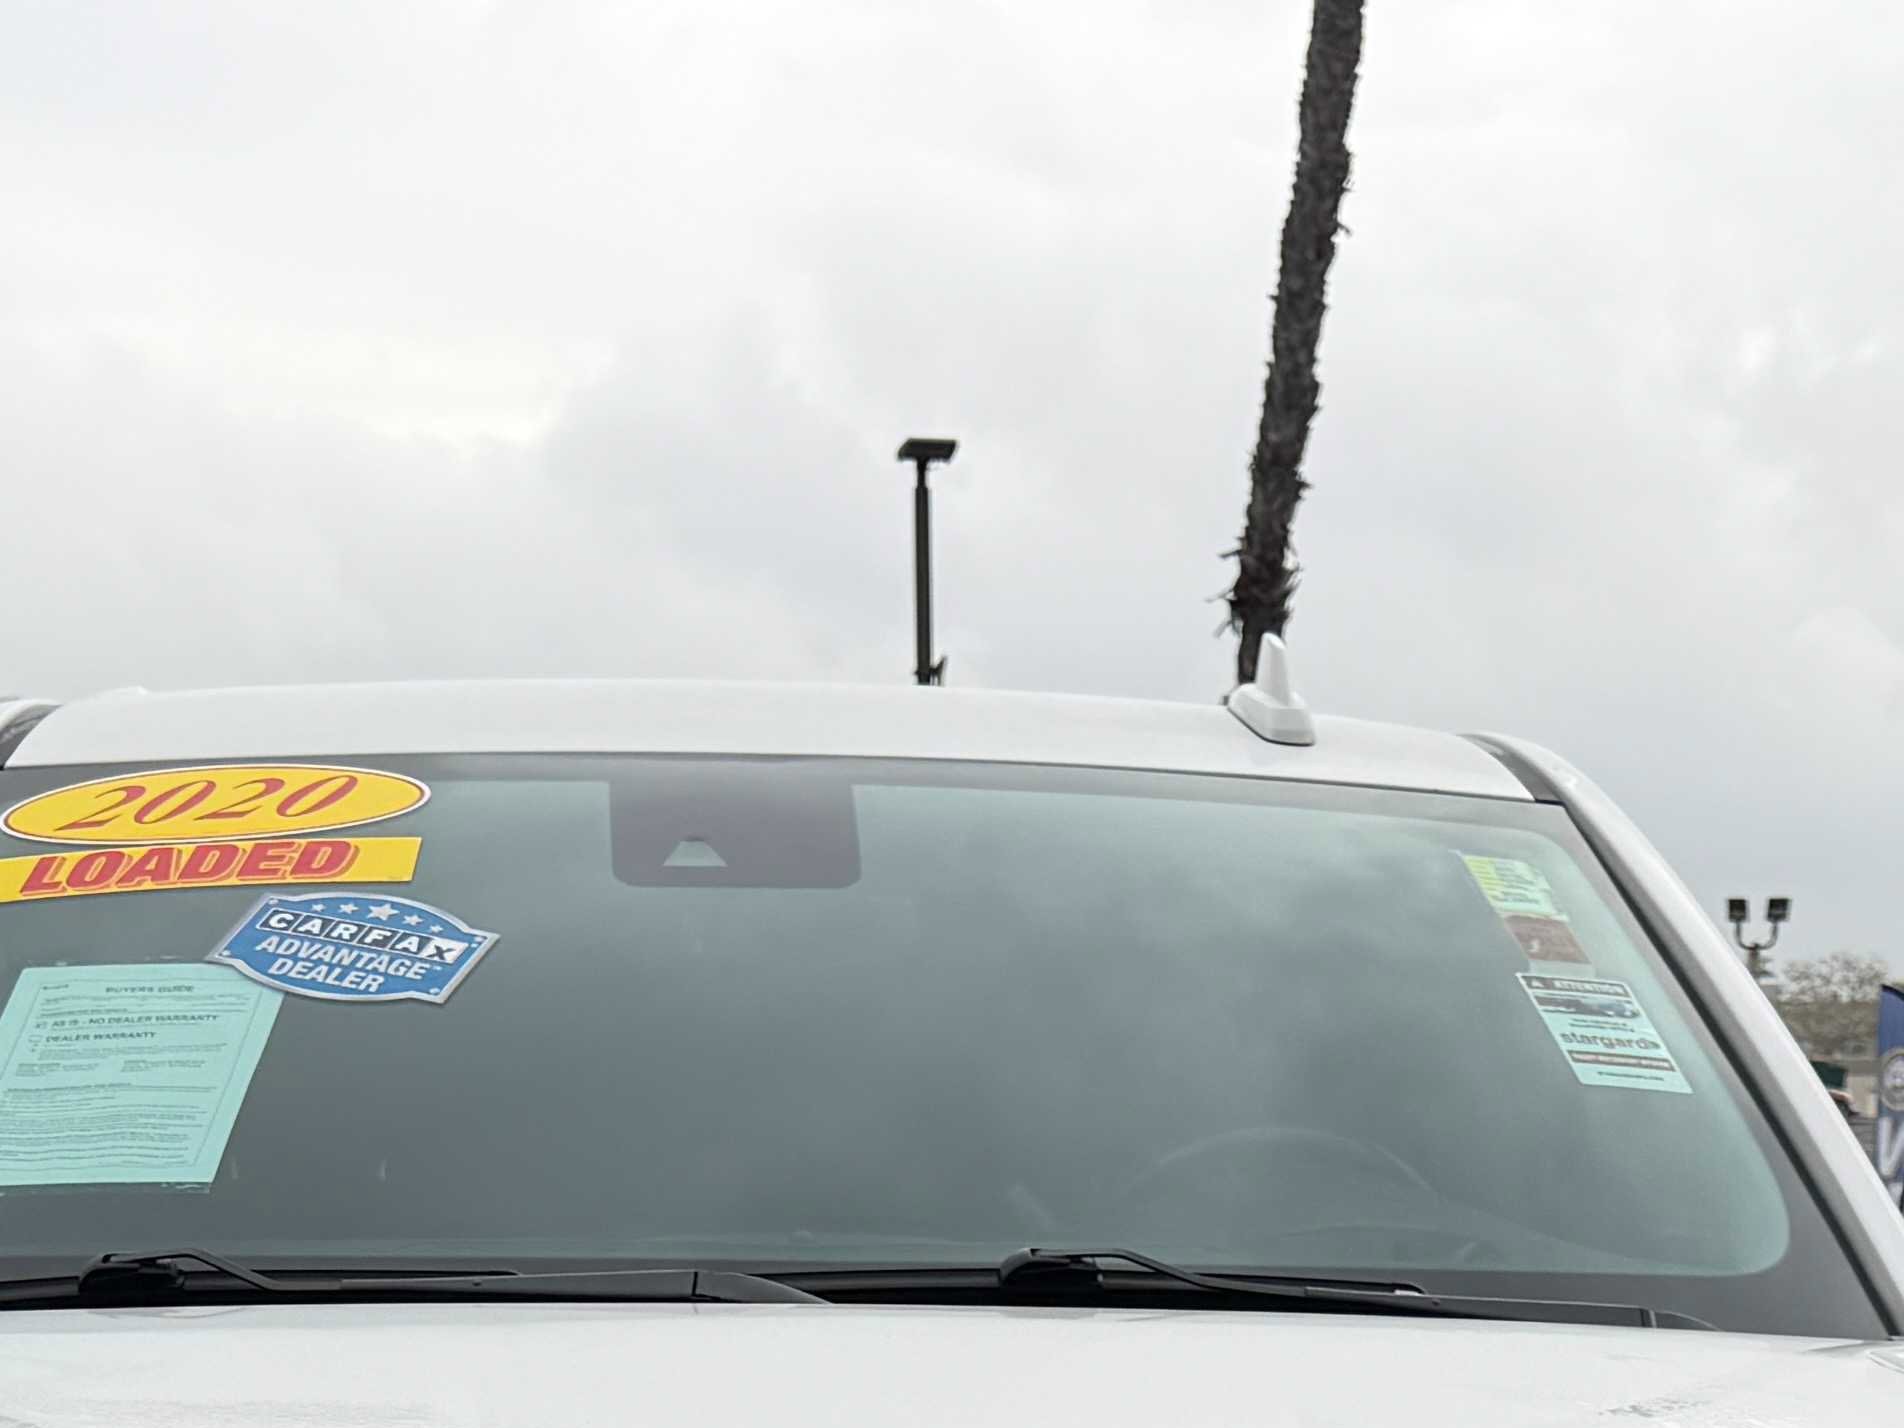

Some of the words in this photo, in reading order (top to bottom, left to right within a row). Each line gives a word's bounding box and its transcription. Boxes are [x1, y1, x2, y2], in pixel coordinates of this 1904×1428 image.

[52, 774, 360, 832] 2020
[19, 839, 362, 898] LOADED
[255, 935, 432, 980] ADVANTAGE
[265, 911, 461, 962] CARFAX
[267, 959, 385, 993] DEALER
[46, 1033, 90, 1043] DEALER
[93, 1031, 157, 1041] WARRANTY
[107, 1015, 153, 1025] DEALER
[155, 1013, 218, 1022] WARRANTY
